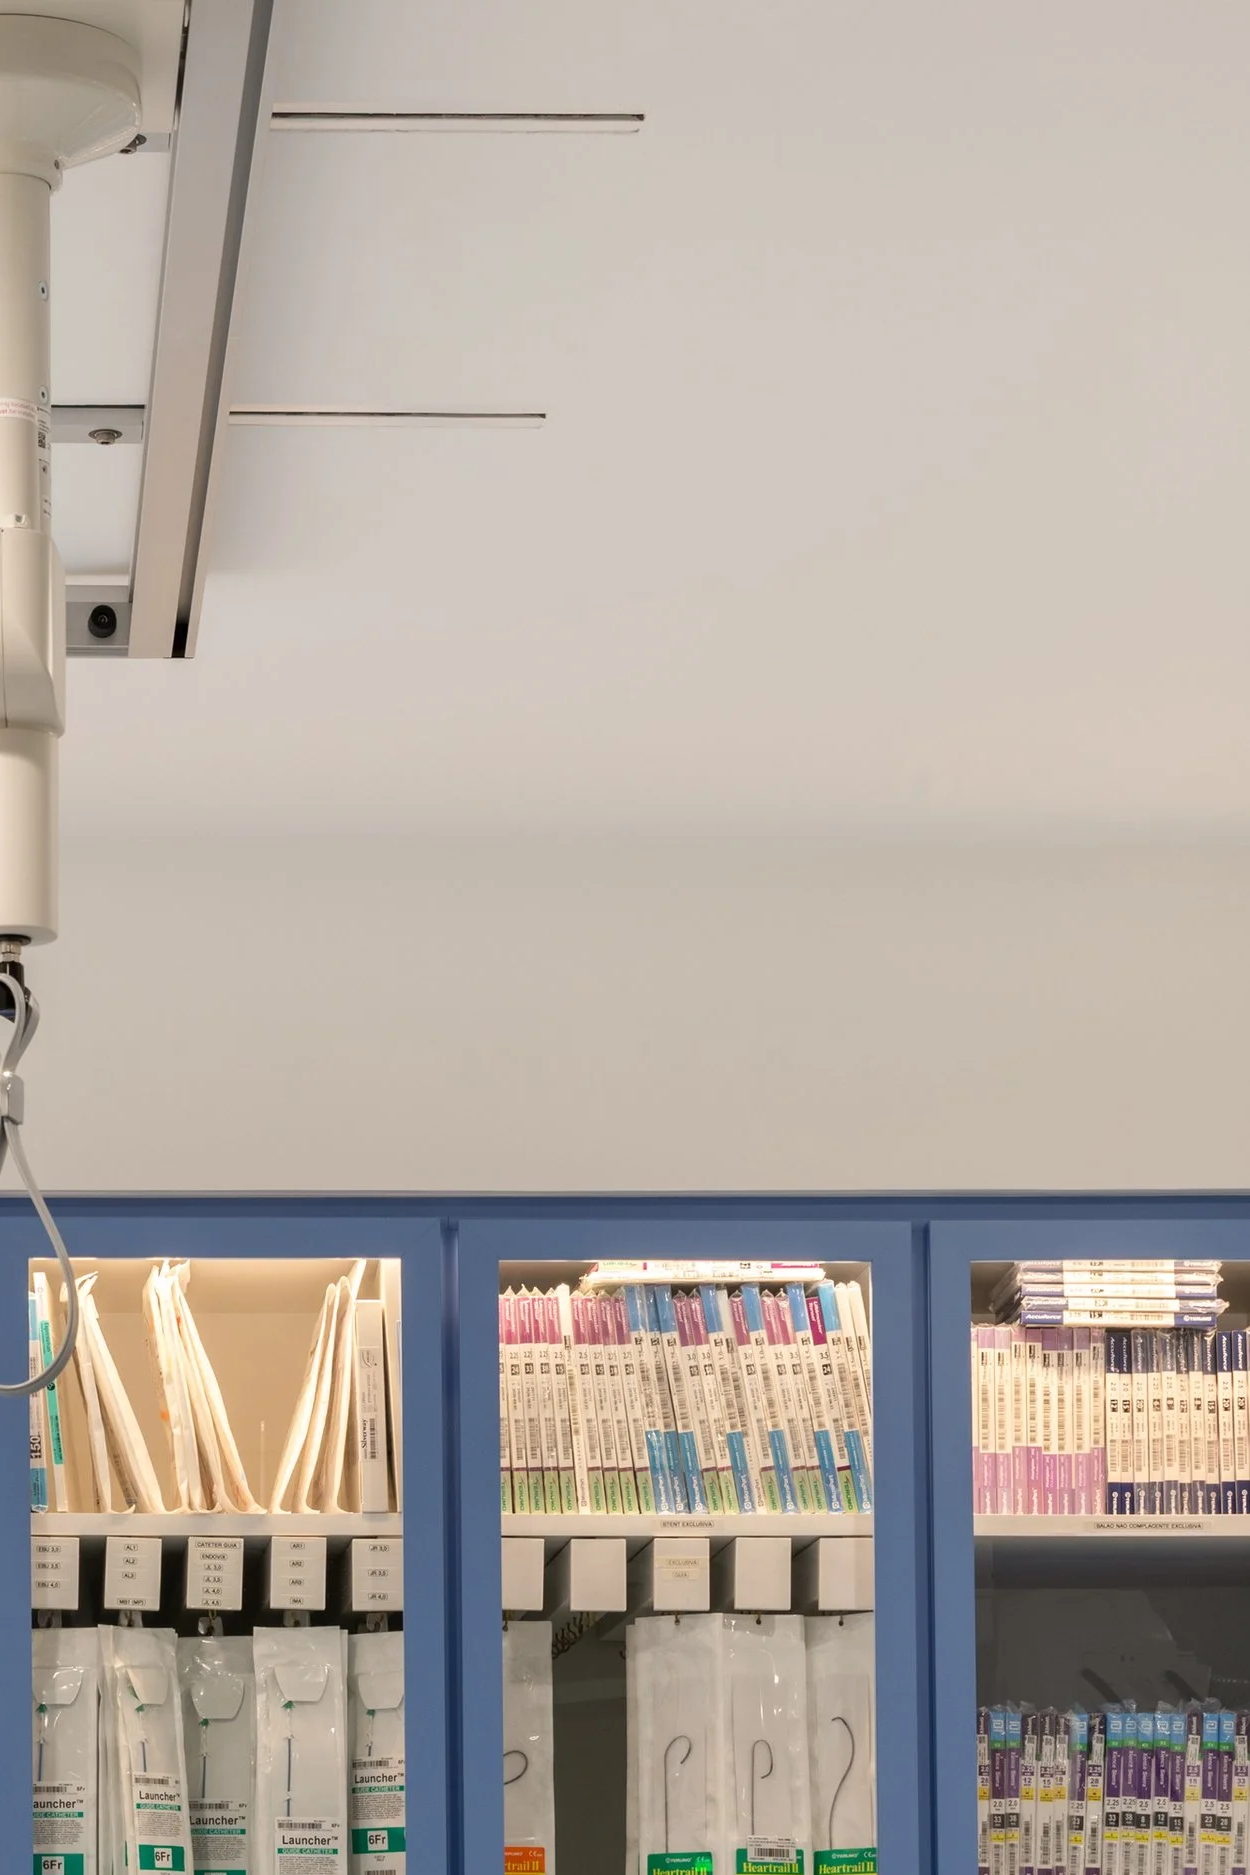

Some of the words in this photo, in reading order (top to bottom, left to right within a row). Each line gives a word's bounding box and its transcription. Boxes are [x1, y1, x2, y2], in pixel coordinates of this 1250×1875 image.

[360, 1419, 368, 1449] Silverway
[31, 1435, 41, 1458] 150
[368, 1834, 387, 1845] 6Fr
[154, 1850, 171, 1861] 6Fr
[42, 1860, 63, 1870] 6Fr
[743, 1862, 790, 1873] Heartrail
[790, 1862, 799, 1873] II
[819, 1862, 865, 1875] Heartrail
[866, 1860, 874, 1872] II
